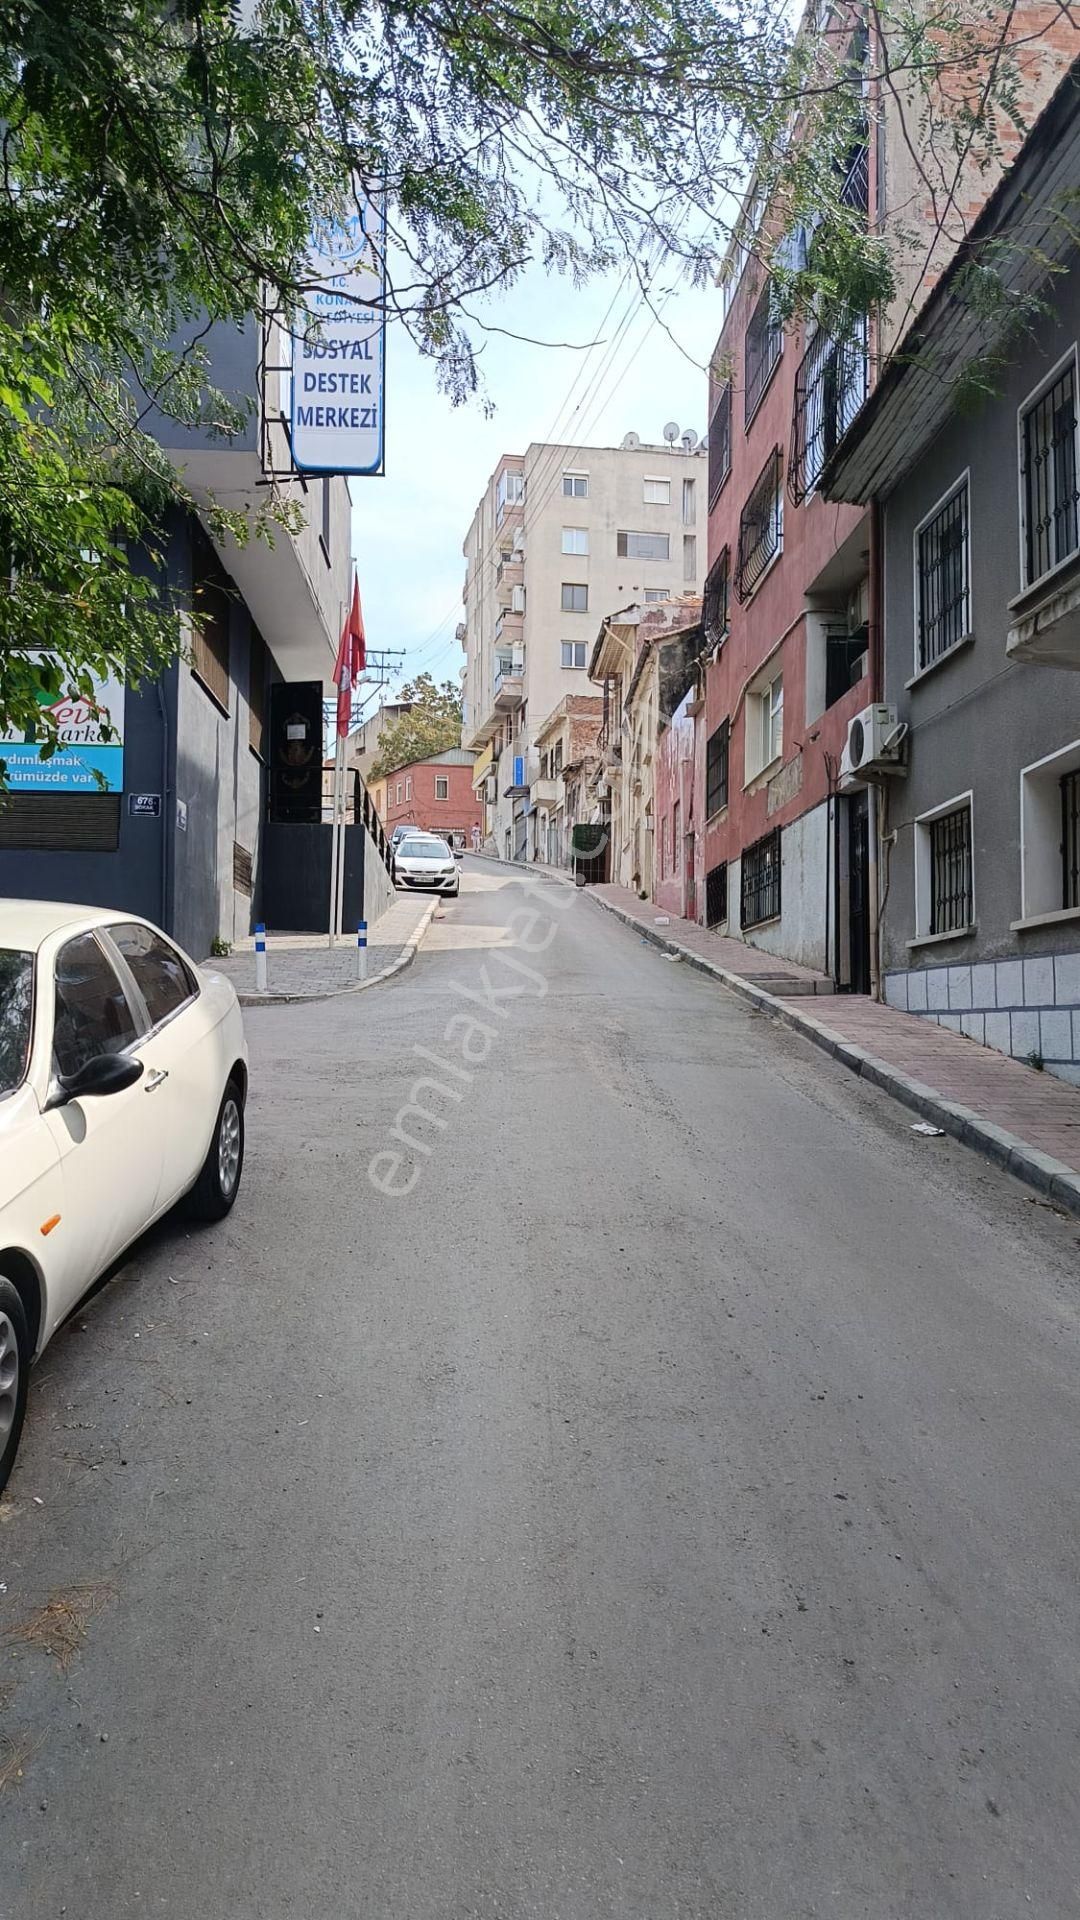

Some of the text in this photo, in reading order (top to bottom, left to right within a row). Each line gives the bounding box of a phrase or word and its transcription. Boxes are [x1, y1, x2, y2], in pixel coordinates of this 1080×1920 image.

[302, 339, 373, 360] SOSYAL
[304, 372, 372, 394] DESTEK
[297, 403, 377, 428] MERKEZİ
